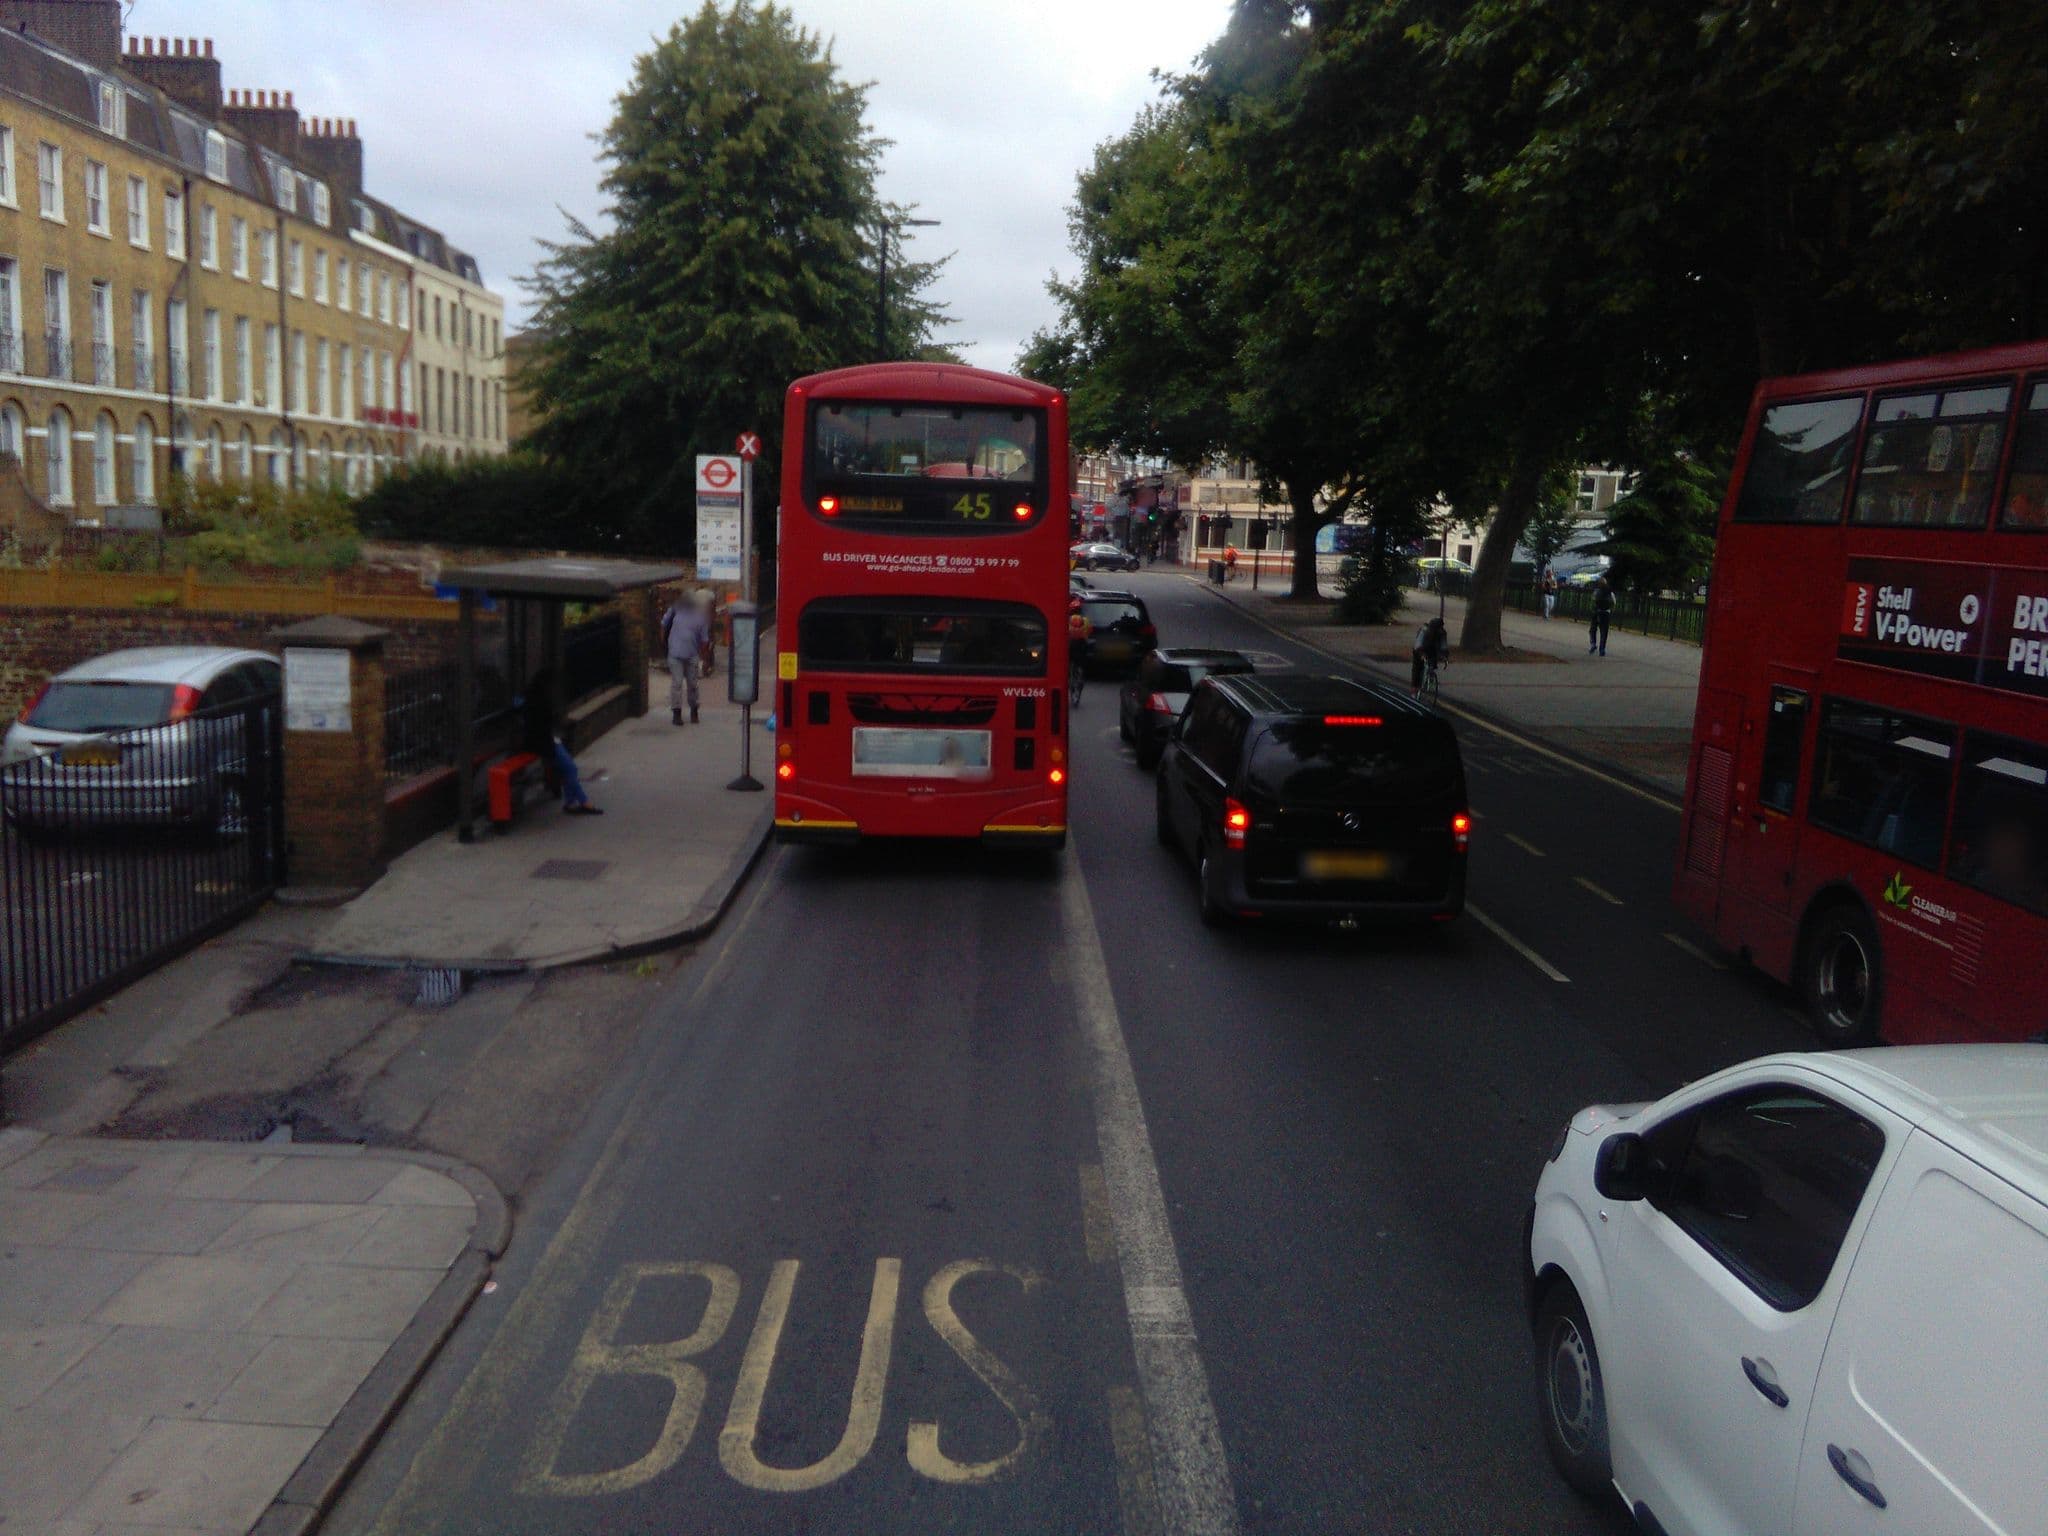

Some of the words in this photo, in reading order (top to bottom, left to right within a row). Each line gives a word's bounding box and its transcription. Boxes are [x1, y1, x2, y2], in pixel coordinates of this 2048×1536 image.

[953, 493, 991, 520] 45
[822, 551, 842, 562] BUS
[843, 553, 877, 563] DRIVER
[879, 554, 933, 565] VACANCIES
[950, 556, 972, 567] 0800
[987, 557, 998, 567] 99
[1007, 558, 1020, 568] 99
[866, 563, 976, 575] www.go-ahead-london.com
[1853, 586, 1869, 633] NEW
[1876, 584, 1913, 612] Shell
[1875, 610, 1969, 653] V-Power
[1003, 687, 1046, 698] WVL266
[512, 1256, 1053, 1496] BUS
